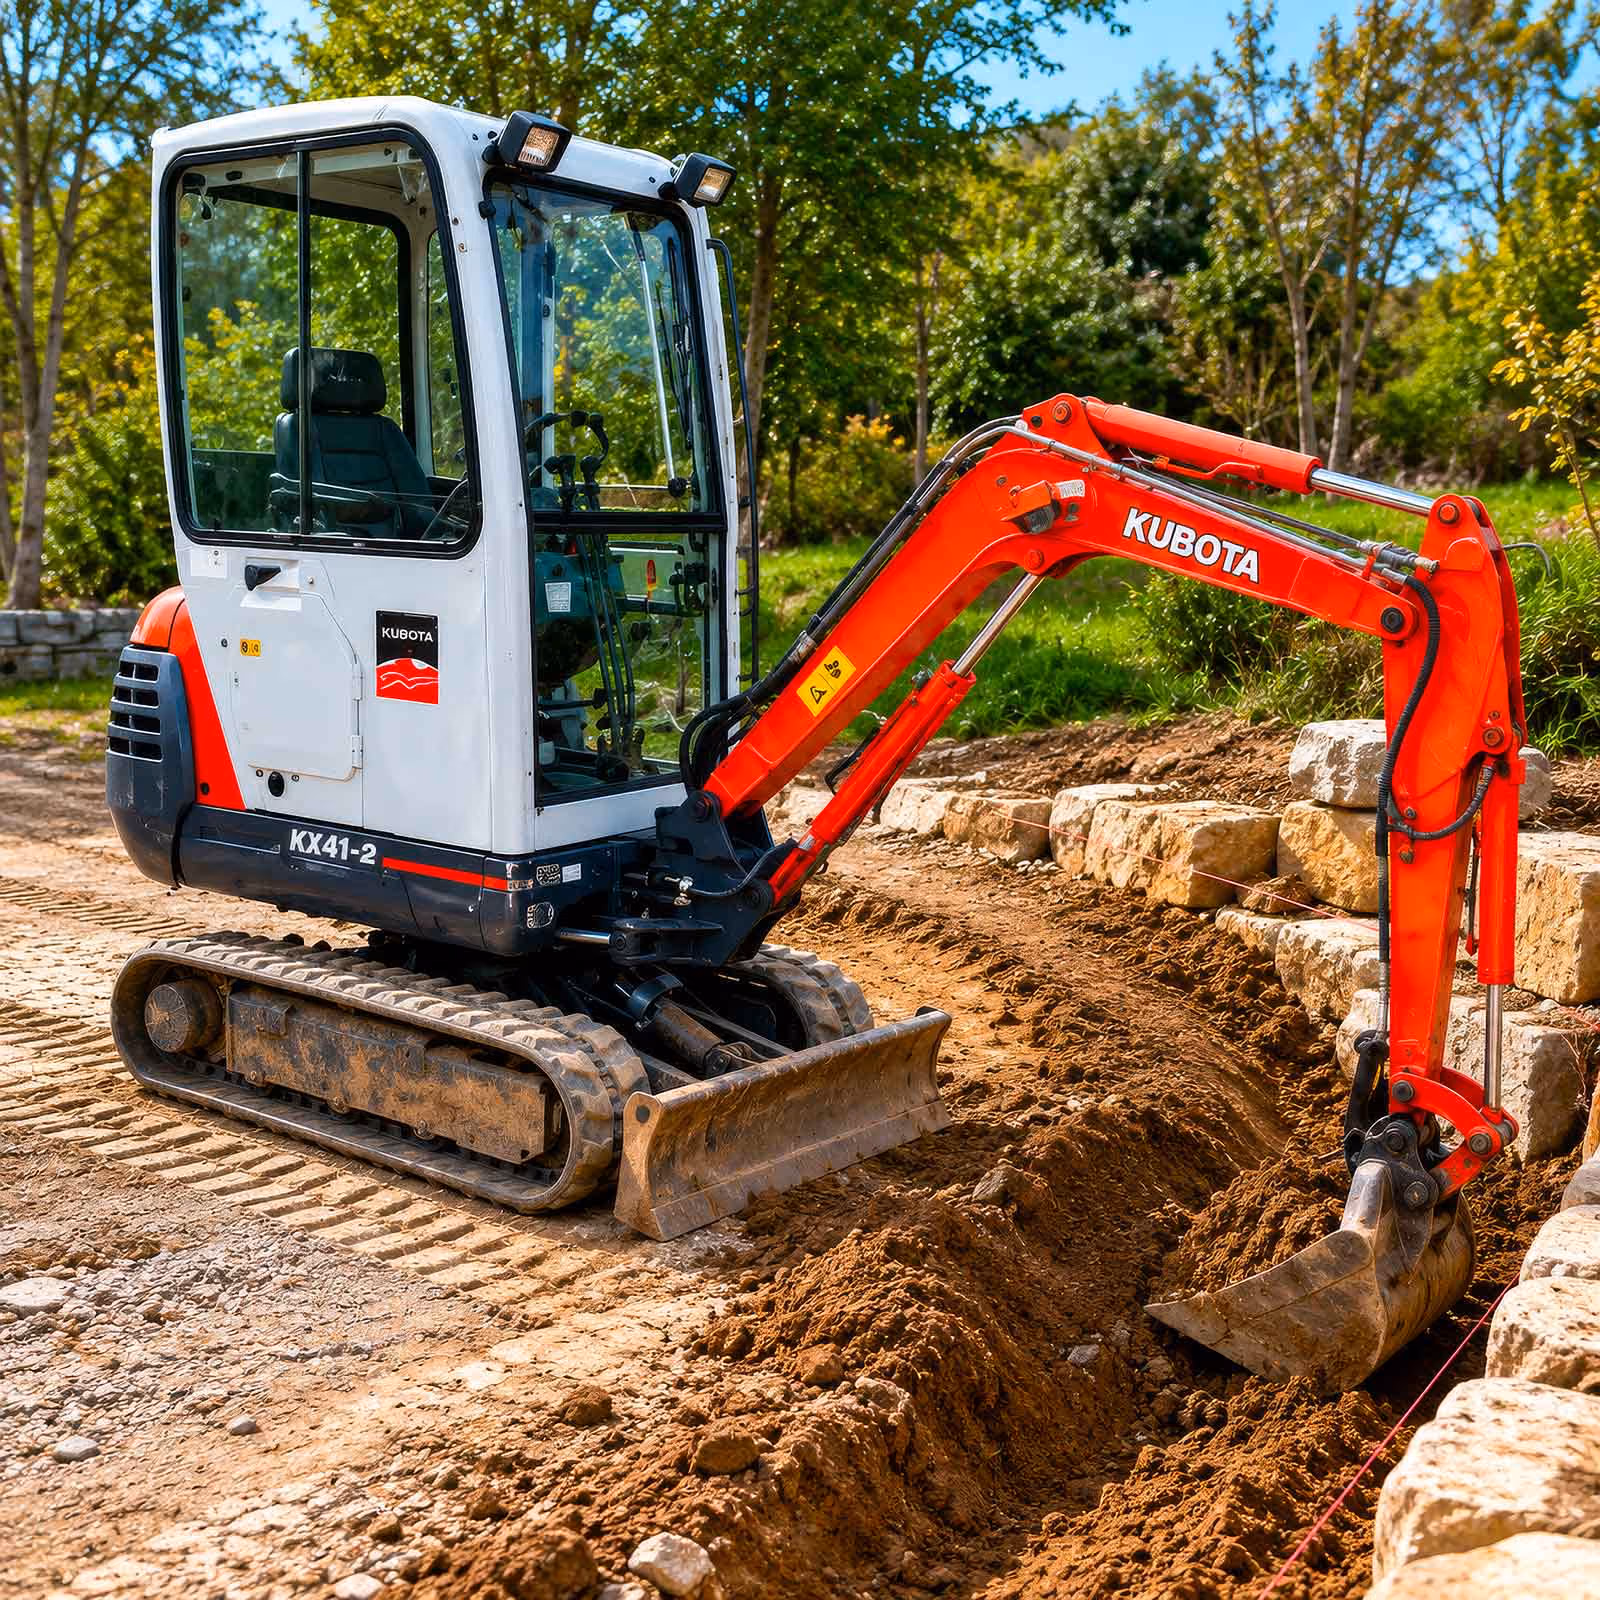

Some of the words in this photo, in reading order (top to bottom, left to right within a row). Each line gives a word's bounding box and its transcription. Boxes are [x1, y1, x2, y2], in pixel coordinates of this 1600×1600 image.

[1123, 507, 1259, 583] KUBOTA
[382, 627, 434, 642] KUBOTA
[289, 828, 376, 865] KX41-2
